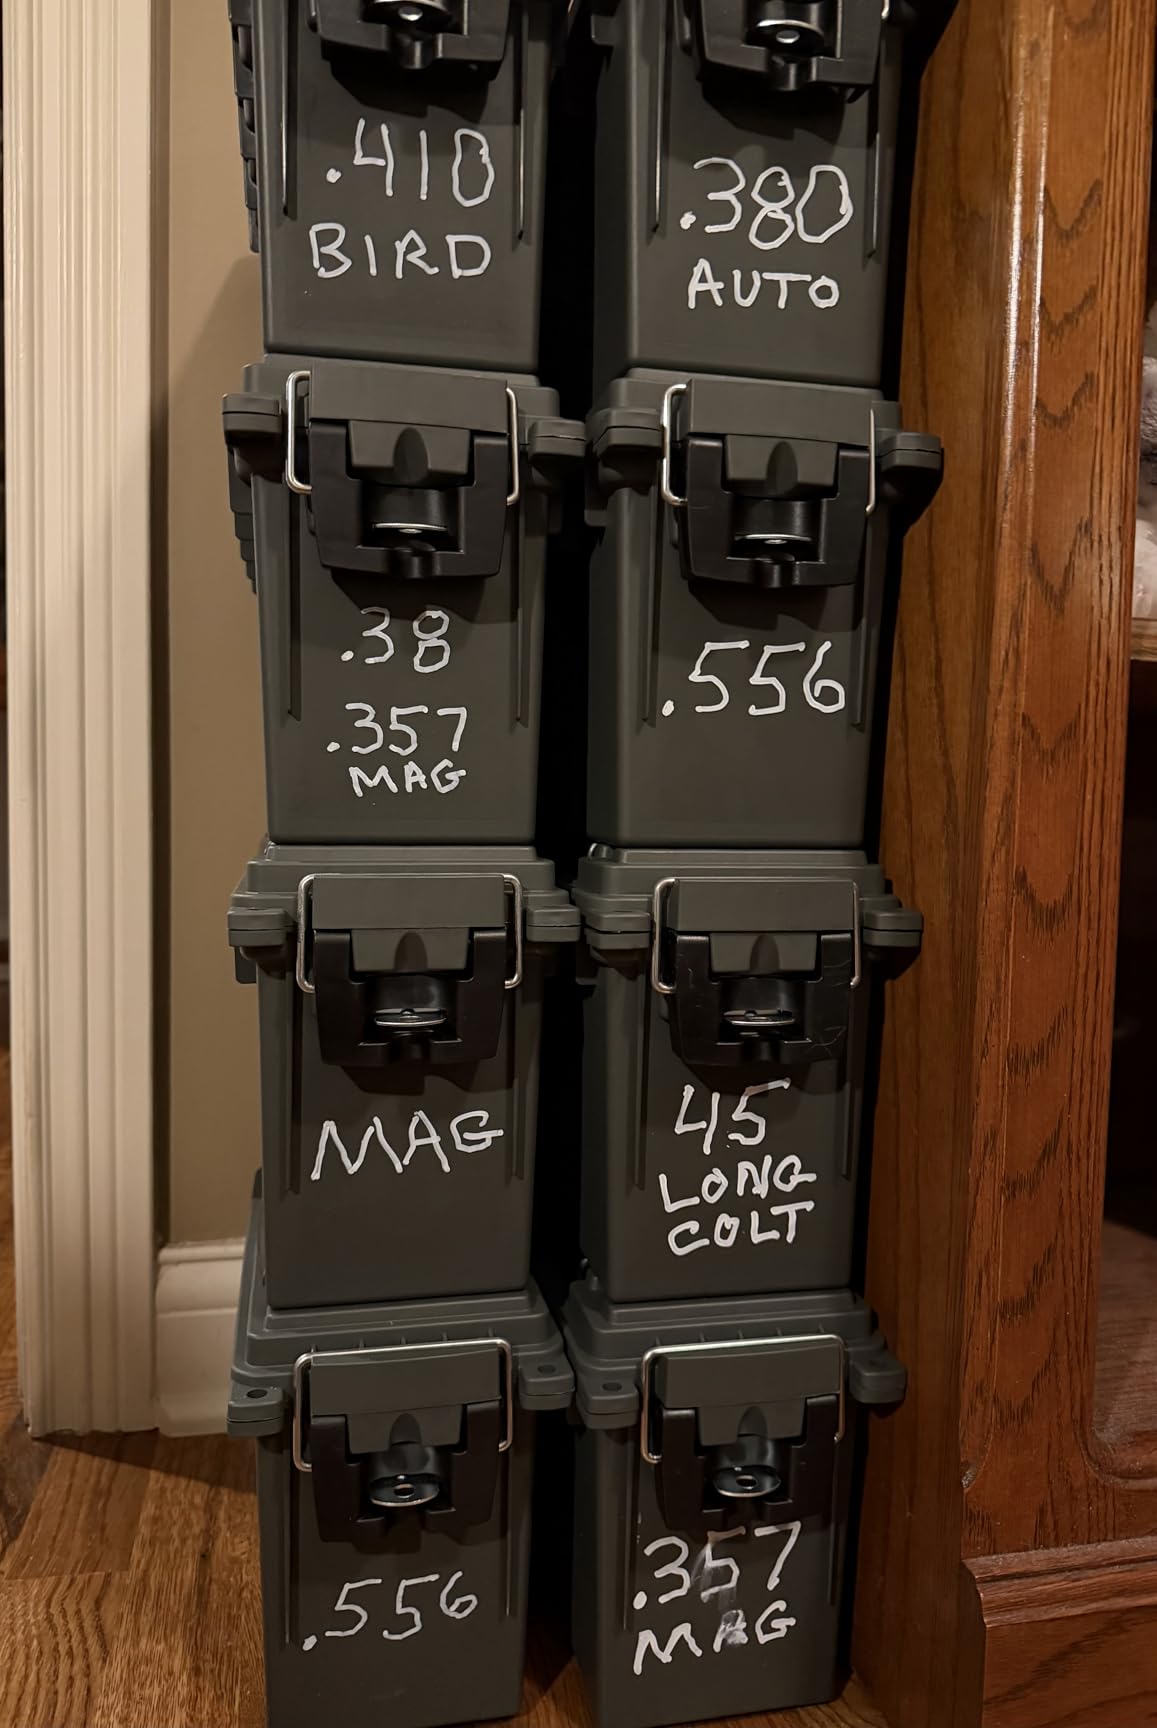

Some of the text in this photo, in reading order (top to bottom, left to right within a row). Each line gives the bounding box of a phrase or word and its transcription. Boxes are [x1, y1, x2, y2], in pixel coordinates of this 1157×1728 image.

[325, 117, 495, 209] .410
[678, 157, 854, 251] .380
[308, 222, 492, 280] BIRD
[687, 258, 841, 310] AUTO
[339, 606, 451, 675] .38
[660, 639, 847, 718] .556
[326, 702, 468, 755] .357
[348, 758, 467, 798] MAG
[310, 1110, 504, 1181] MAG
[673, 1078, 792, 1155] 45
[658, 1154, 817, 1214] LONG
[667, 1200, 815, 1256] COLT
[632, 1520, 802, 1611] .357
[301, 1571, 478, 1651] .556
[632, 1599, 798, 1676] MAG
